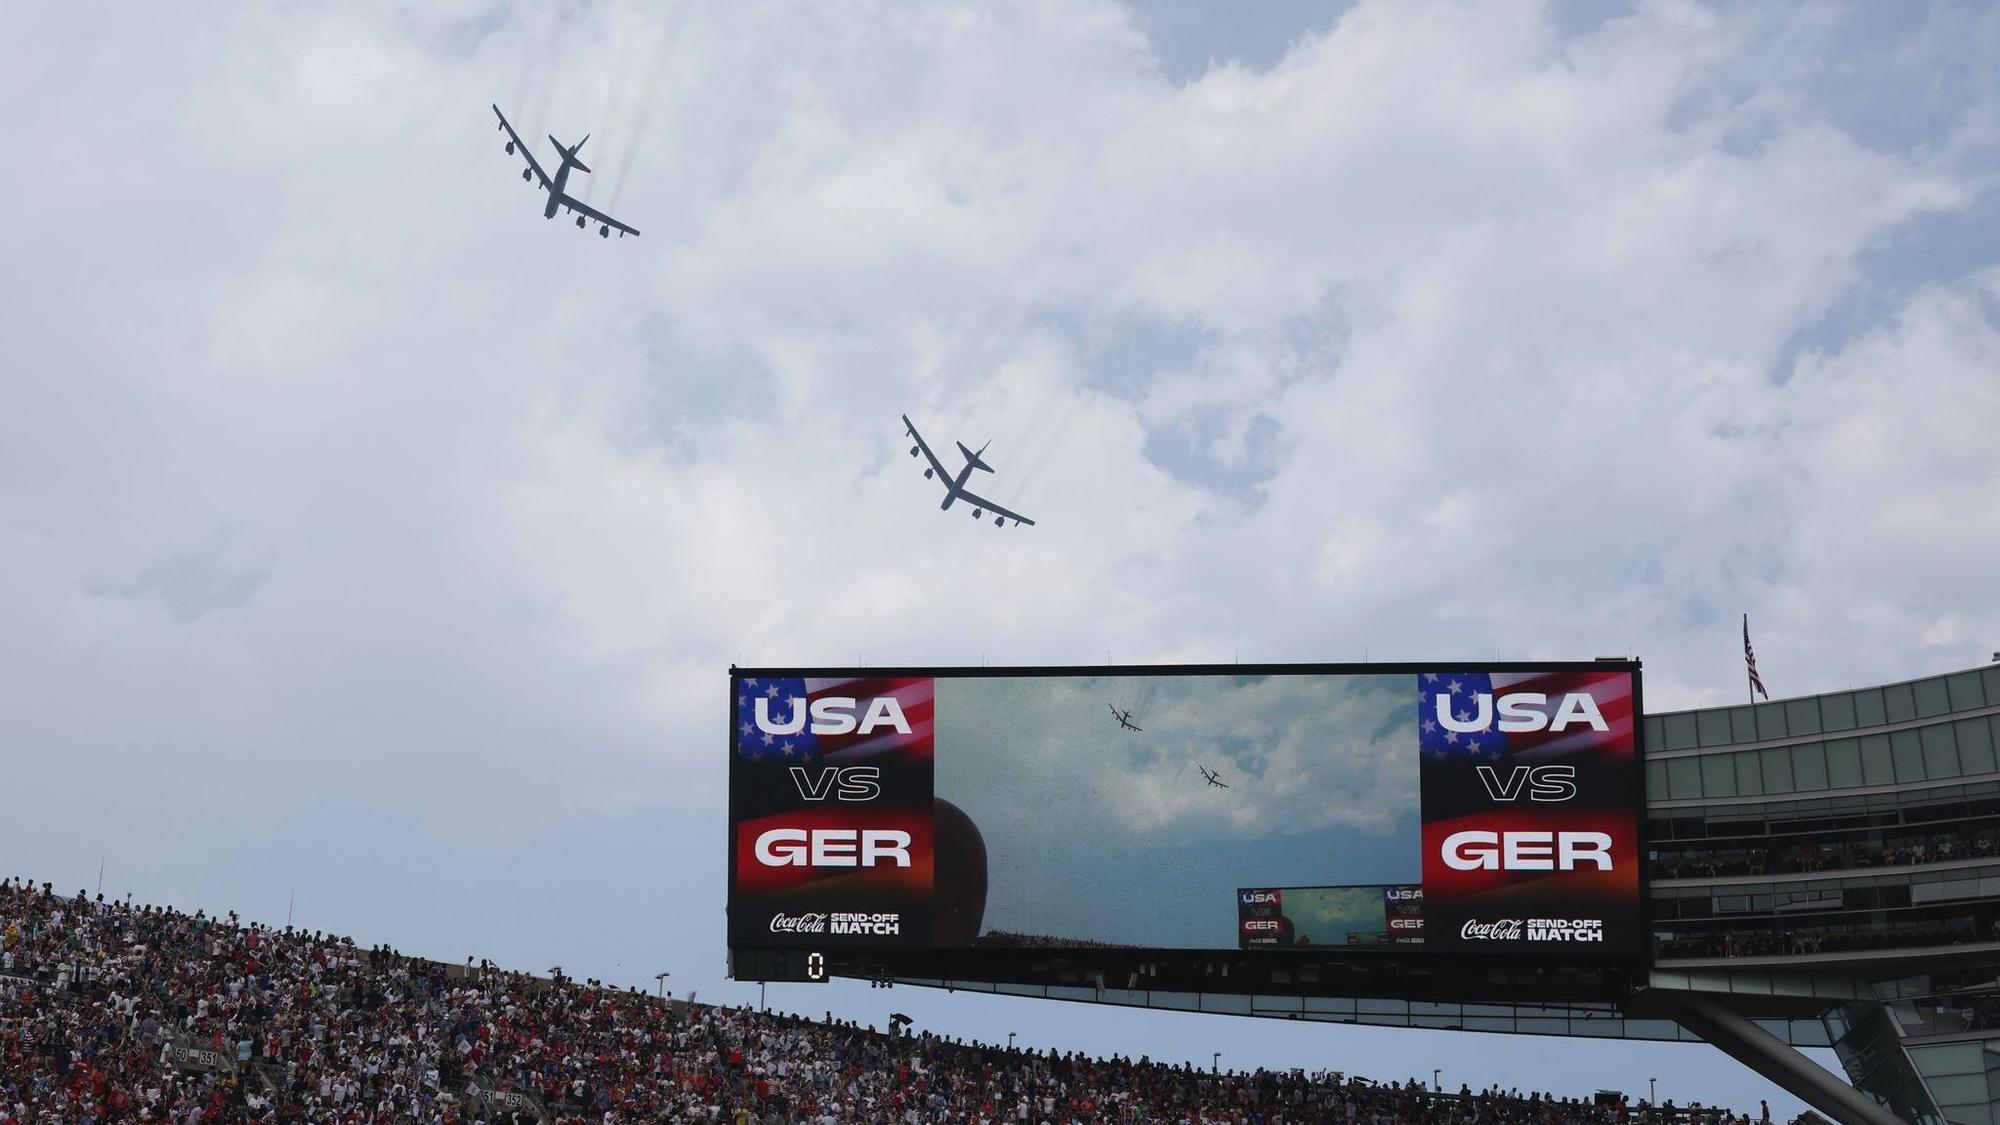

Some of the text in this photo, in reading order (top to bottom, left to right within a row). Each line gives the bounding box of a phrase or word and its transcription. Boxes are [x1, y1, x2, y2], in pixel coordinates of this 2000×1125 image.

[754, 697, 912, 735] USA
[1436, 692, 1610, 733] USA
[788, 766, 881, 801] VS
[1476, 765, 1577, 802] VS
[754, 828, 912, 867] GER
[1440, 830, 1613, 871] GER
[1243, 893, 1277, 903] USA
[769, 912, 828, 933] Coca-Cola
[831, 913, 899, 923] SEND-OFF
[1245, 921, 1279, 930] GER
[1527, 919, 1602, 929] SEND-OFF
[831, 922, 899, 935] MATCH
[1460, 918, 1525, 940] Coca-Cola
[1527, 929, 1603, 942] MATCH
[808, 952, 824, 980] 0
[176, 1049, 187, 1060] 50
[201, 1052, 217, 1064] 351
[507, 1094, 522, 1106] 352
